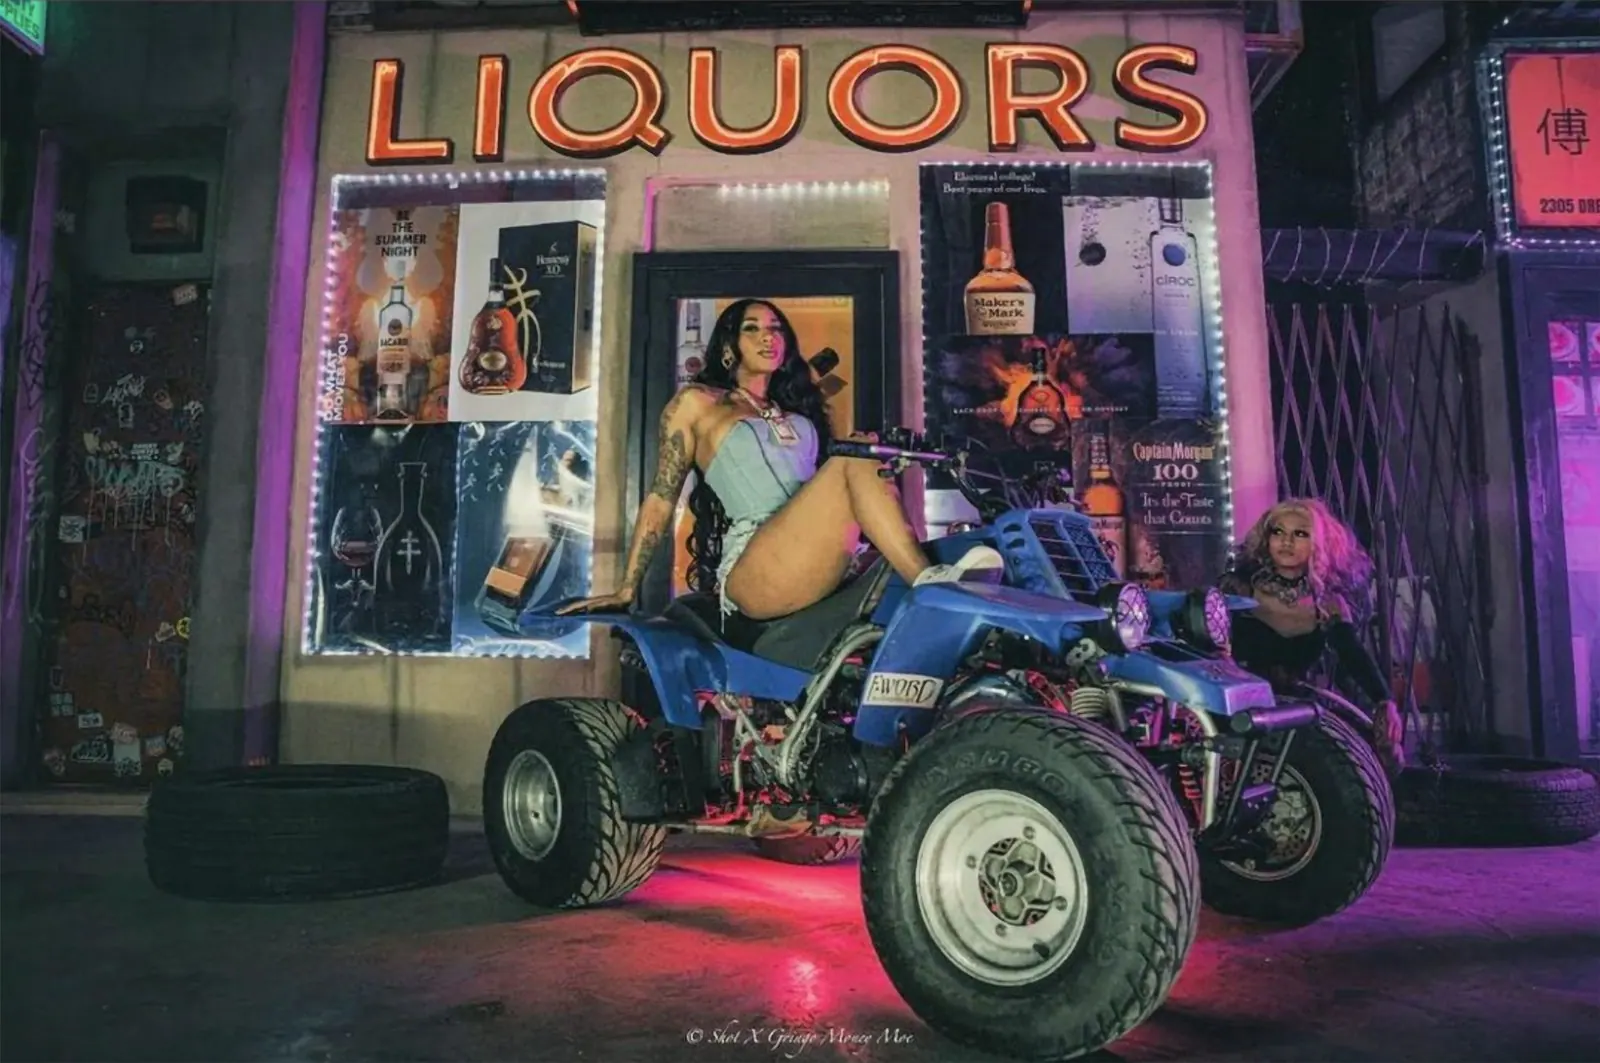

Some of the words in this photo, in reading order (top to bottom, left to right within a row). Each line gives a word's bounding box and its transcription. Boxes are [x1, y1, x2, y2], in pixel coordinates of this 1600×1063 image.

[365, 43, 1210, 164] LIQUORS
[1536, 108, 1590, 155] 傅
[943, 183, 965, 193] Best
[994, 183, 1005, 193] of
[1539, 198, 1574, 213] 2305
[391, 222, 414, 233] THE
[375, 233, 427, 246] SUMMER
[380, 246, 418, 257] NIGHT
[974, 296, 1025, 307] Maker's
[988, 307, 1025, 318] Mark
[335, 333, 349, 365] YOU
[1132, 442, 1173, 462] Captain
[1171, 442, 1215, 463] Morgan
[1152, 463, 1199, 480] 100
[1161, 492, 1181, 508] the
[1180, 492, 1215, 508] Taste
[1143, 509, 1166, 525] that
[1168, 509, 1213, 526] Counts
